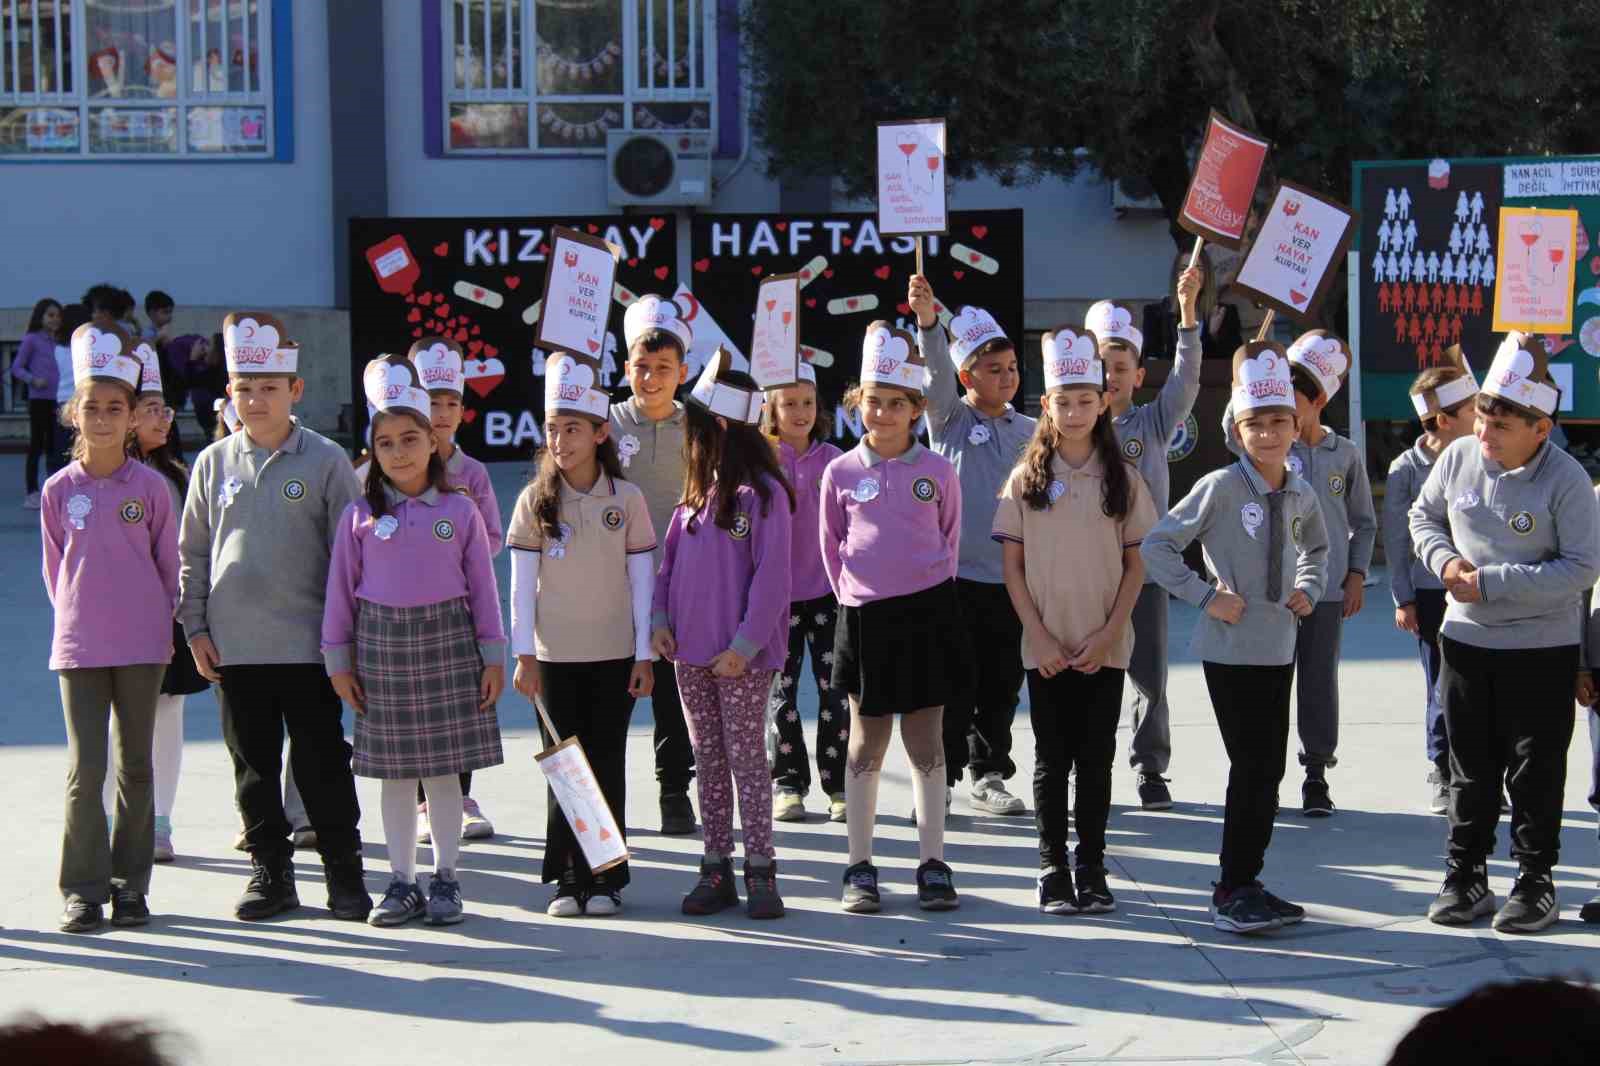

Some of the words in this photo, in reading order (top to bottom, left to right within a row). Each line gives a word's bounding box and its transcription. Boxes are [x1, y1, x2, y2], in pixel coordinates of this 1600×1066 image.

[1294, 221, 1320, 240] KAN
[463, 225, 657, 266] KIZAY
[1292, 235, 1311, 249] VER
[1279, 243, 1312, 264] HAYAT
[577, 271, 599, 286] KAN
[578, 286, 595, 297] VER
[568, 295, 598, 313] HAYAT
